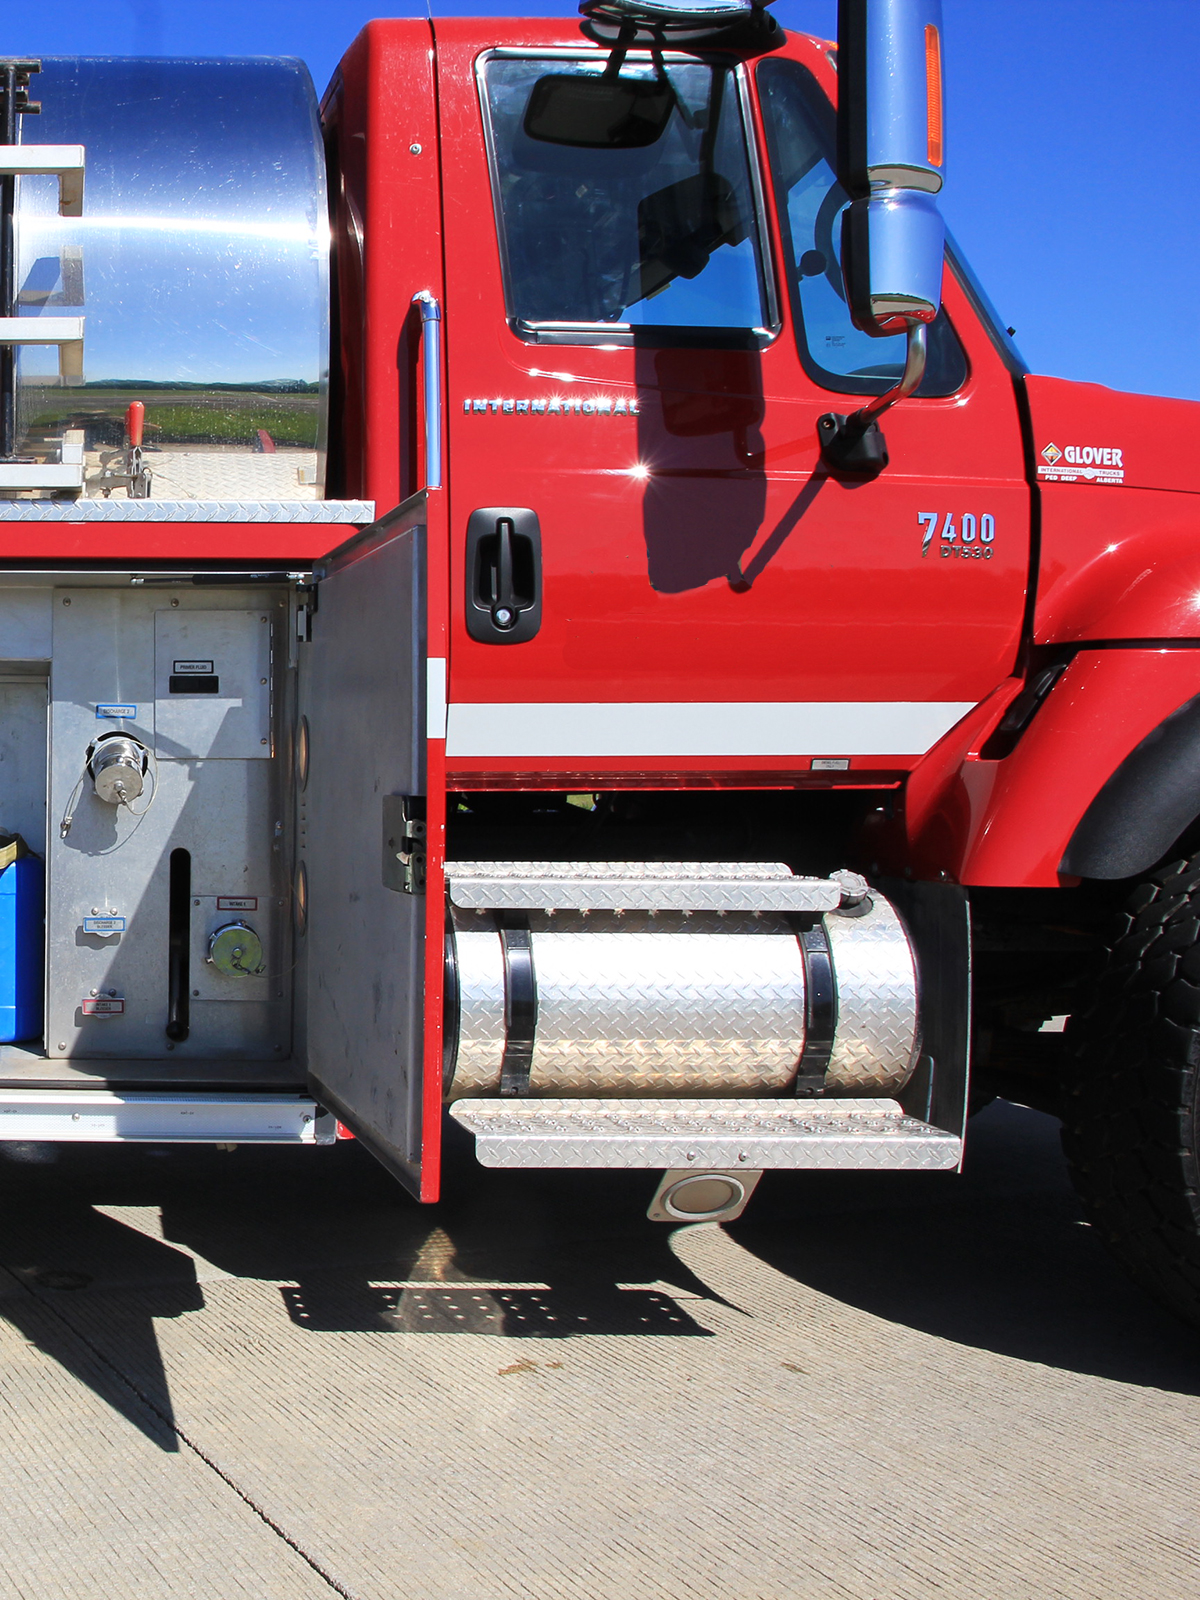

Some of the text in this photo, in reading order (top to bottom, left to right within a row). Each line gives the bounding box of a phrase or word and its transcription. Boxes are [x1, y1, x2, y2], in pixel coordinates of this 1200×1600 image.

[464, 397, 640, 415] INTERNATIONAL
[1064, 446, 1124, 468] GLOVER
[917, 511, 996, 558] 7400
